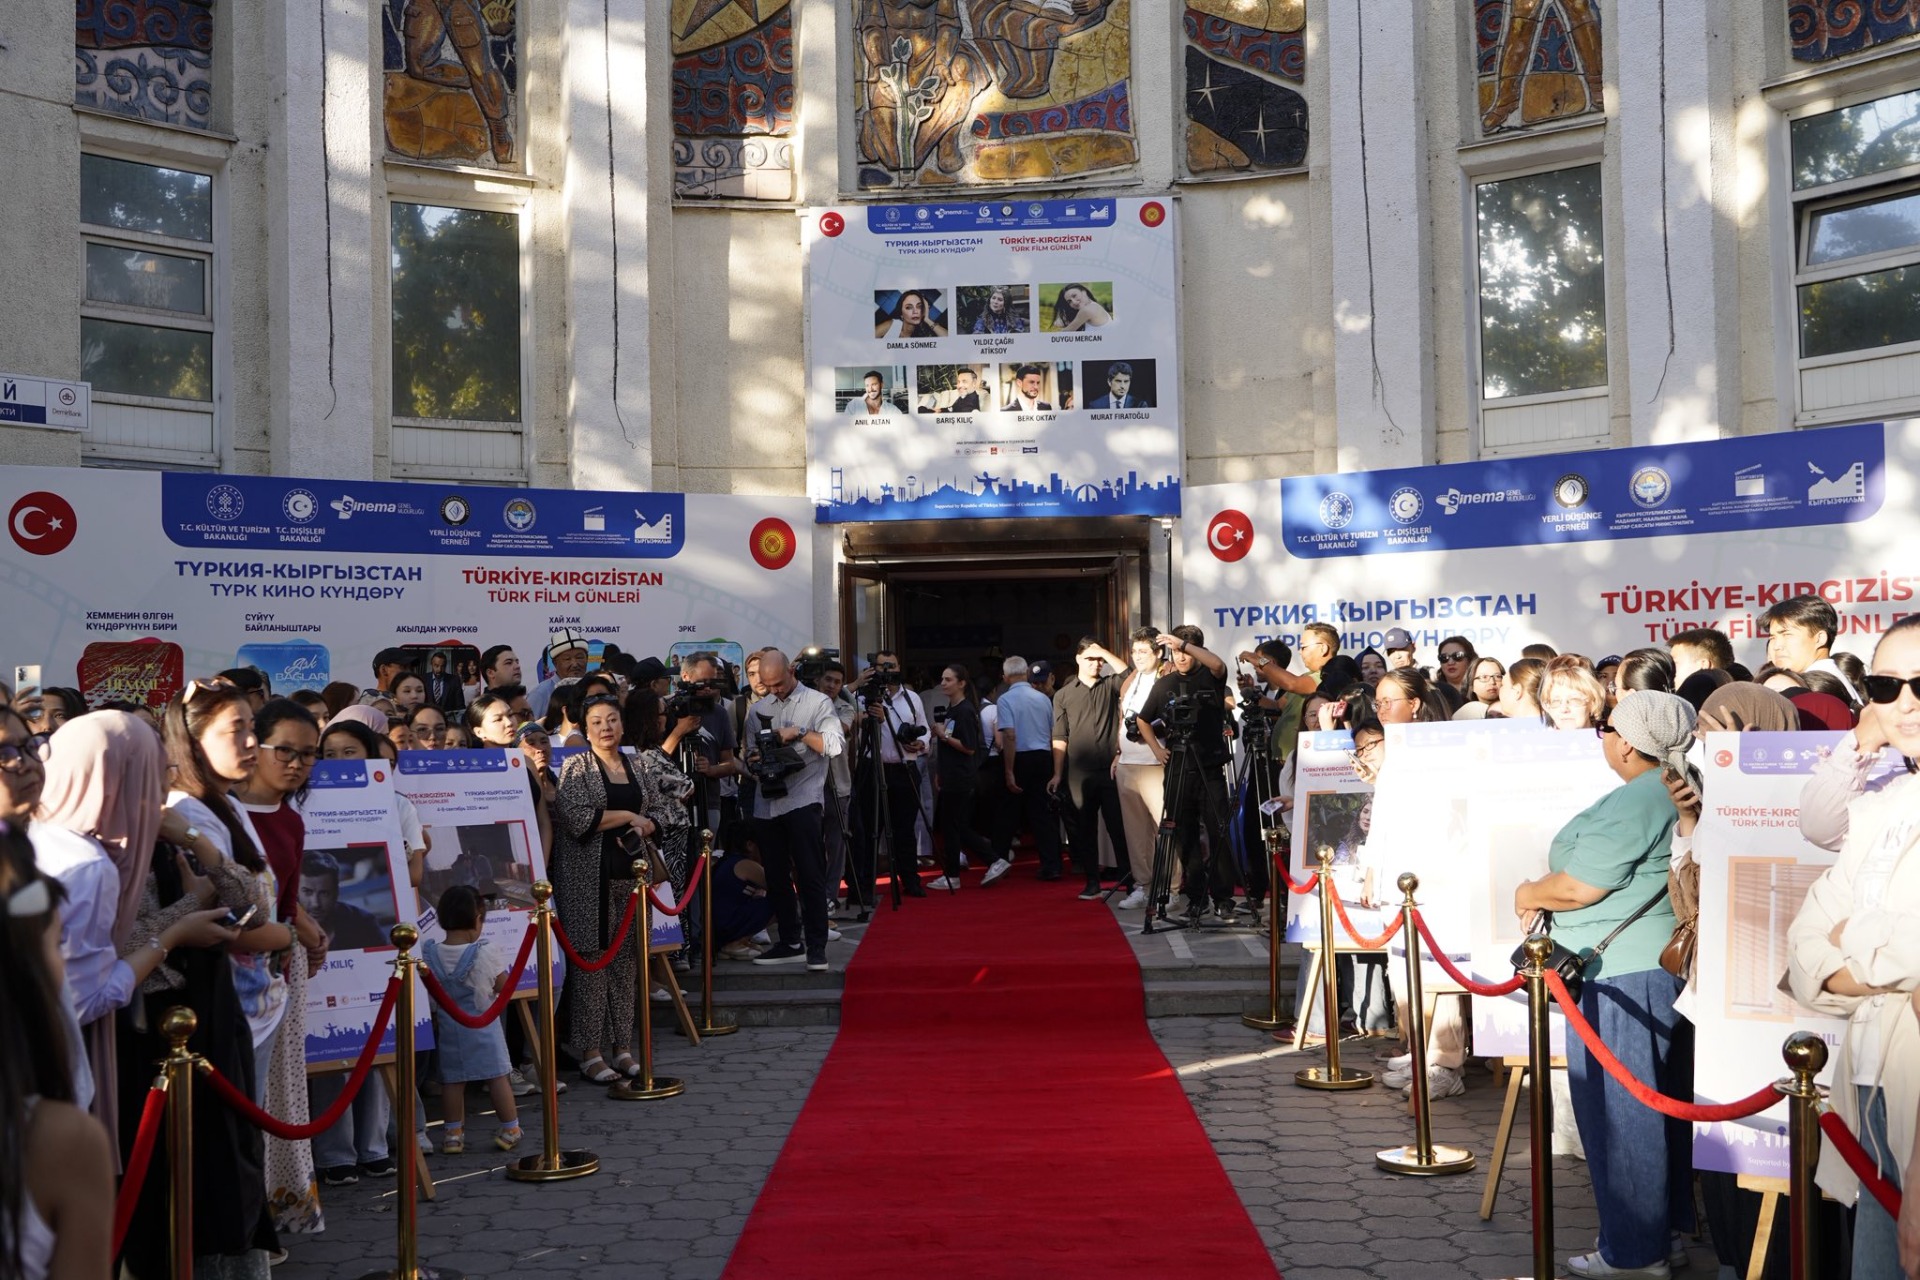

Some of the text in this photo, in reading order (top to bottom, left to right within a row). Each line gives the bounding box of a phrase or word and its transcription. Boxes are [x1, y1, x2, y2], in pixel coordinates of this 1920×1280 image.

[885, 238, 983, 248] ТҮРКИЯ-КЫРГЫЗСТАН
[1000, 234, 1092, 244] TÜRKİYE-KIRGIZİSTAN
[1050, 243, 1081, 251] GÜNLERİ
[973, 337, 1014, 346] YILDIZ ÇAĞRI
[1051, 335, 1102, 343] DUYGU MERCAN
[887, 341, 937, 350] DAMLA SÖNMEZ
[936, 416, 973, 425] BARIŞ KILIÇ
[1035, 414, 1057, 422] OKTAY
[1090, 411, 1150, 421] MURAT FIRATOĞLU
[870, 418, 891, 426] ALTAN
[1447, 491, 1505, 507] Sinema
[342, 497, 396, 514] Sinema
[1542, 511, 1602, 523] YERLİ DÜŞÜNCE
[180, 523, 270, 534] T.C. KÜLTÜR VE TURİZM
[1555, 520, 1589, 532] DERNEĞİ
[203, 532, 248, 541] BAKANLIĞI
[429, 529, 481, 540] YERLİ DÜŞÜNCE
[1297, 535, 1310, 543] T.C.
[1310, 533, 1339, 542] KÜLTÜR
[1350, 530, 1378, 540] TURİZM
[1383, 529, 1396, 537] T.C.
[279, 534, 322, 543] BAKANLIĞI
[440, 537, 470, 546] DERNEĞİ
[1387, 536, 1428, 545] BAKANLIĞI
[1318, 540, 1358, 550] BAKANLIĞI
[174, 560, 422, 581] ТҮРКИЯ-КЫРГЫЗСТАН
[462, 566, 663, 586] TÜRKİYE-KIRGIZİSTAN
[210, 583, 405, 600] ТҮРК КИНО КҮНДӨРҮ
[488, 587, 641, 603] TÜRK FİLM GÜNLERİ
[1213, 593, 1537, 628] ТҮРКИЯ-КЫРГЫЗСТАН
[86, 612, 174, 620] ХЕММЕНИН ӨЛГӨН
[244, 613, 275, 622] СҮЙҮҮ
[549, 615, 564, 624] ХАЙ
[86, 622, 178, 631] КҮНДӨРҮНҮН БИРИ
[244, 622, 321, 633] БАЙЛАНЫШТАРЫ
[396, 625, 478, 634] АКЫЛДАН ЖҮРӨККӨ
[549, 625, 620, 634] КАРӨЗ-ХАЖИВАТ
[678, 625, 696, 633] ЭРКЕ
[1731, 818, 1758, 827] TÜRK
[1761, 818, 1785, 828] FİLM
[330, 959, 354, 970] KILIÇ
[1748, 1157, 1781, 1168] Supported
